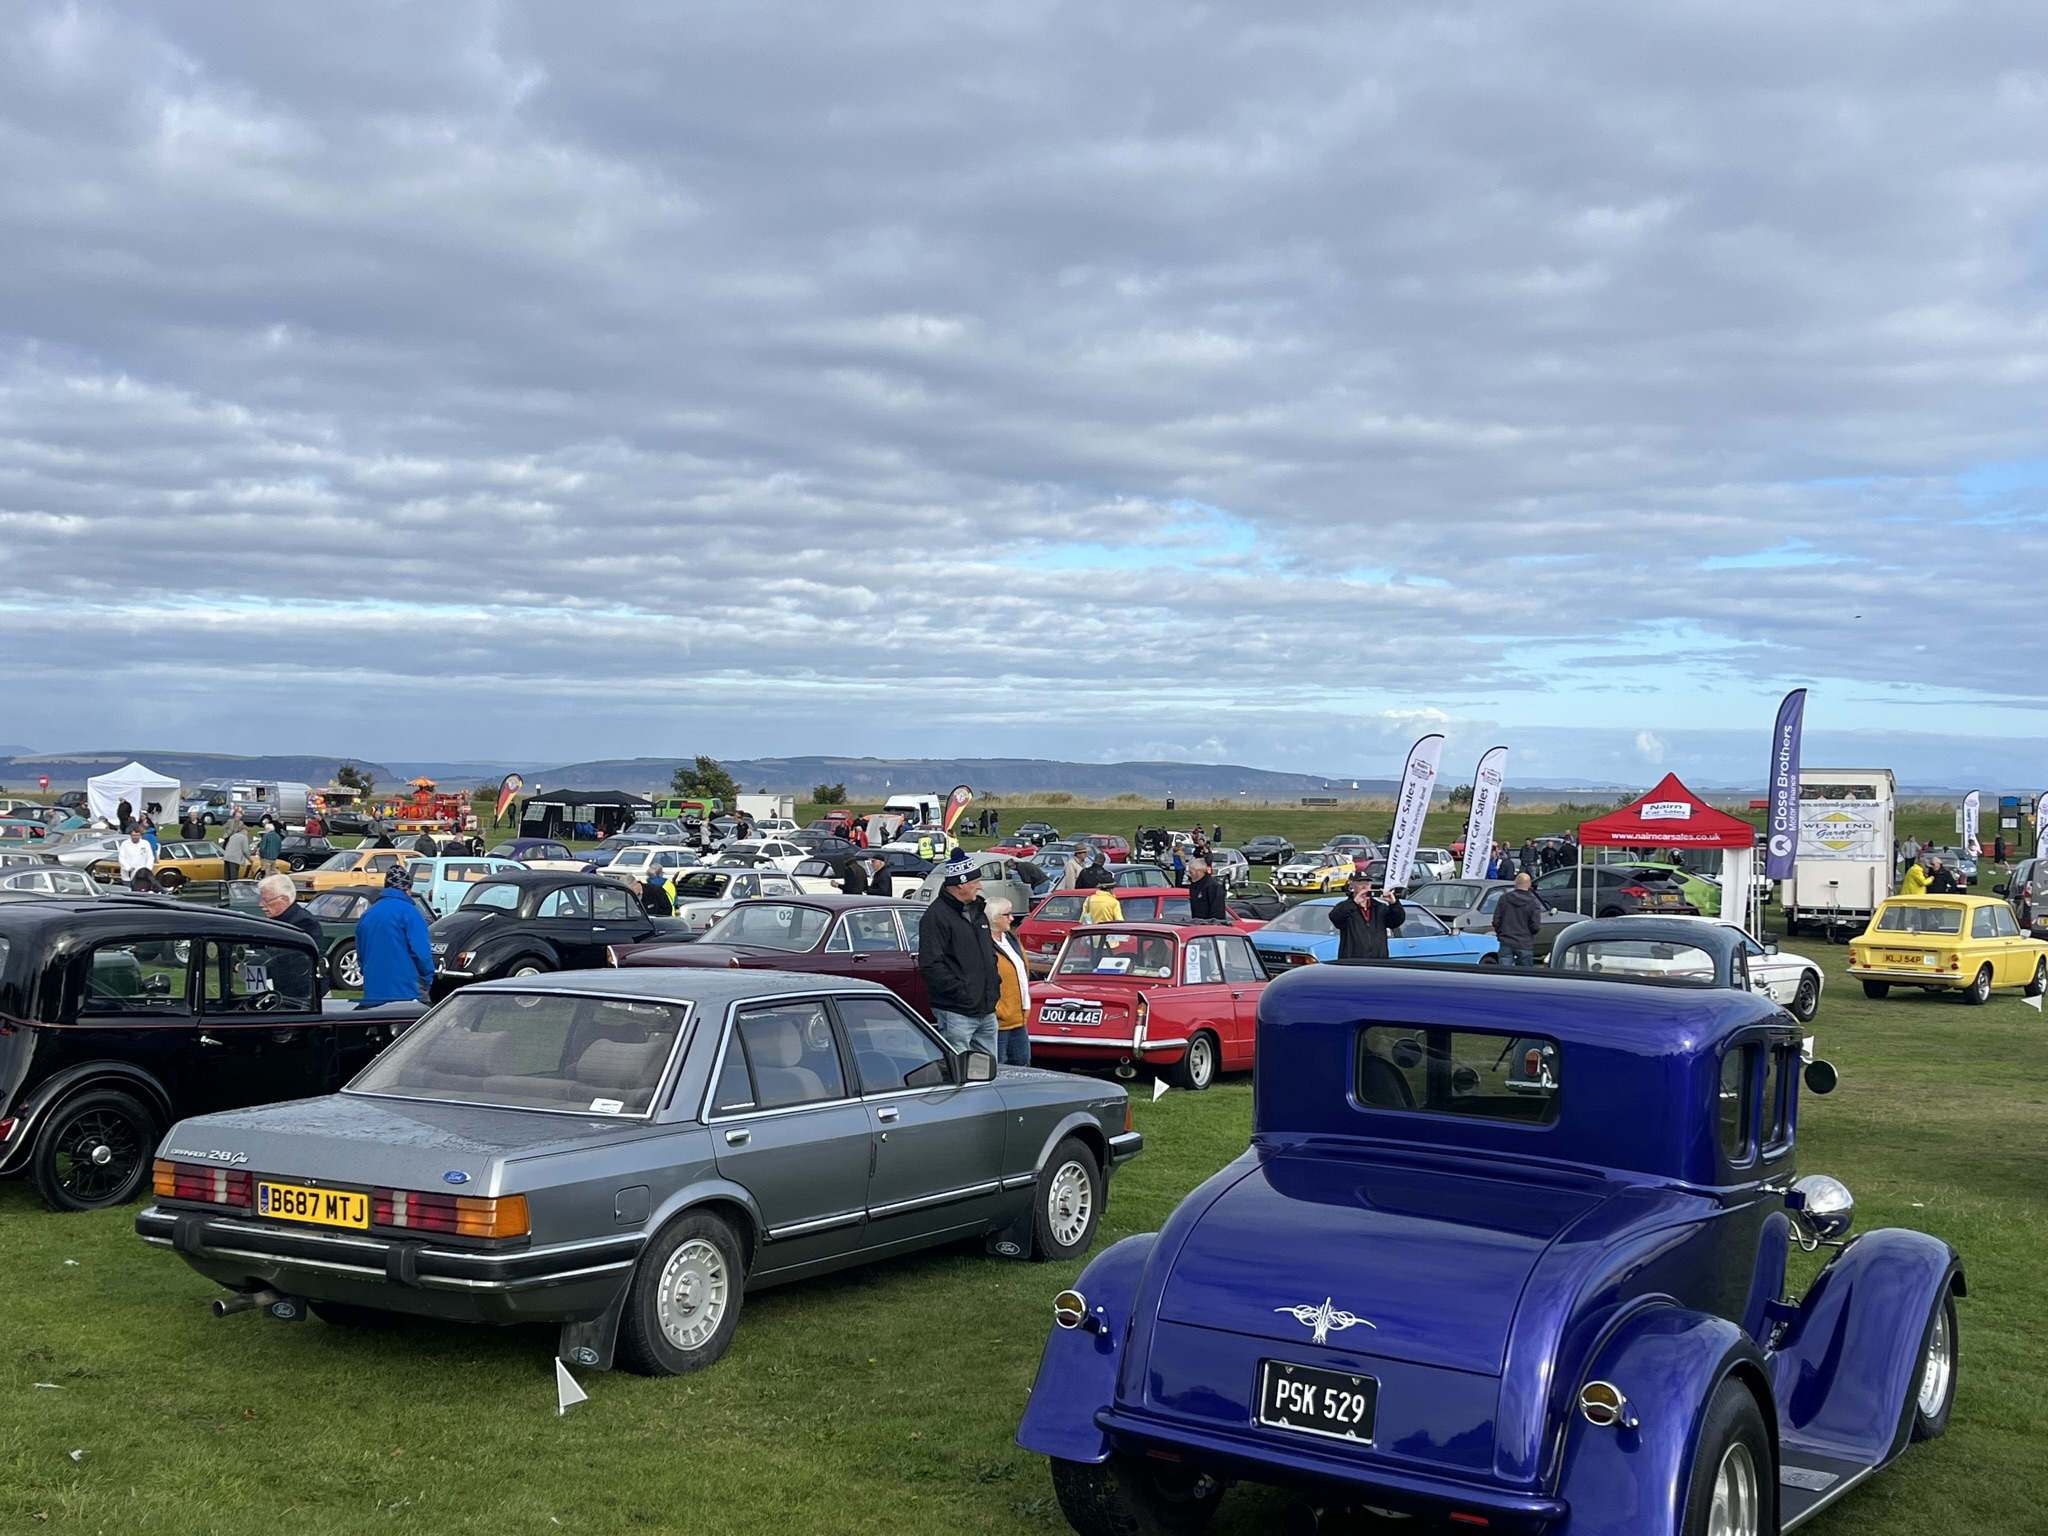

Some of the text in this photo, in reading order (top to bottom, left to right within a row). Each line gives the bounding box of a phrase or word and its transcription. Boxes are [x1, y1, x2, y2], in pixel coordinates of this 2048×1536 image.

[1774, 725, 1793, 831] Close Brothers
[1650, 803, 1683, 811] Nairn
[1788, 774, 1797, 832] Motor Finance
[1390, 782, 1416, 881] Nairn Car Sales
[1465, 788, 1488, 874] Nairn Car Sales
[1611, 832, 1721, 842] www.nairncarsales.co.uk
[1815, 828, 1859, 839] Garage
[779, 910, 792, 921] 02
[1885, 954, 1921, 964] KLJ 54P
[1042, 1010, 1066, 1022] JOU
[1067, 1011, 1100, 1024] 444E
[170, 1148, 207, 1158] GRANADA
[271, 1187, 365, 1223] B687 MTJ
[1275, 1378, 1365, 1424] PSK 529
